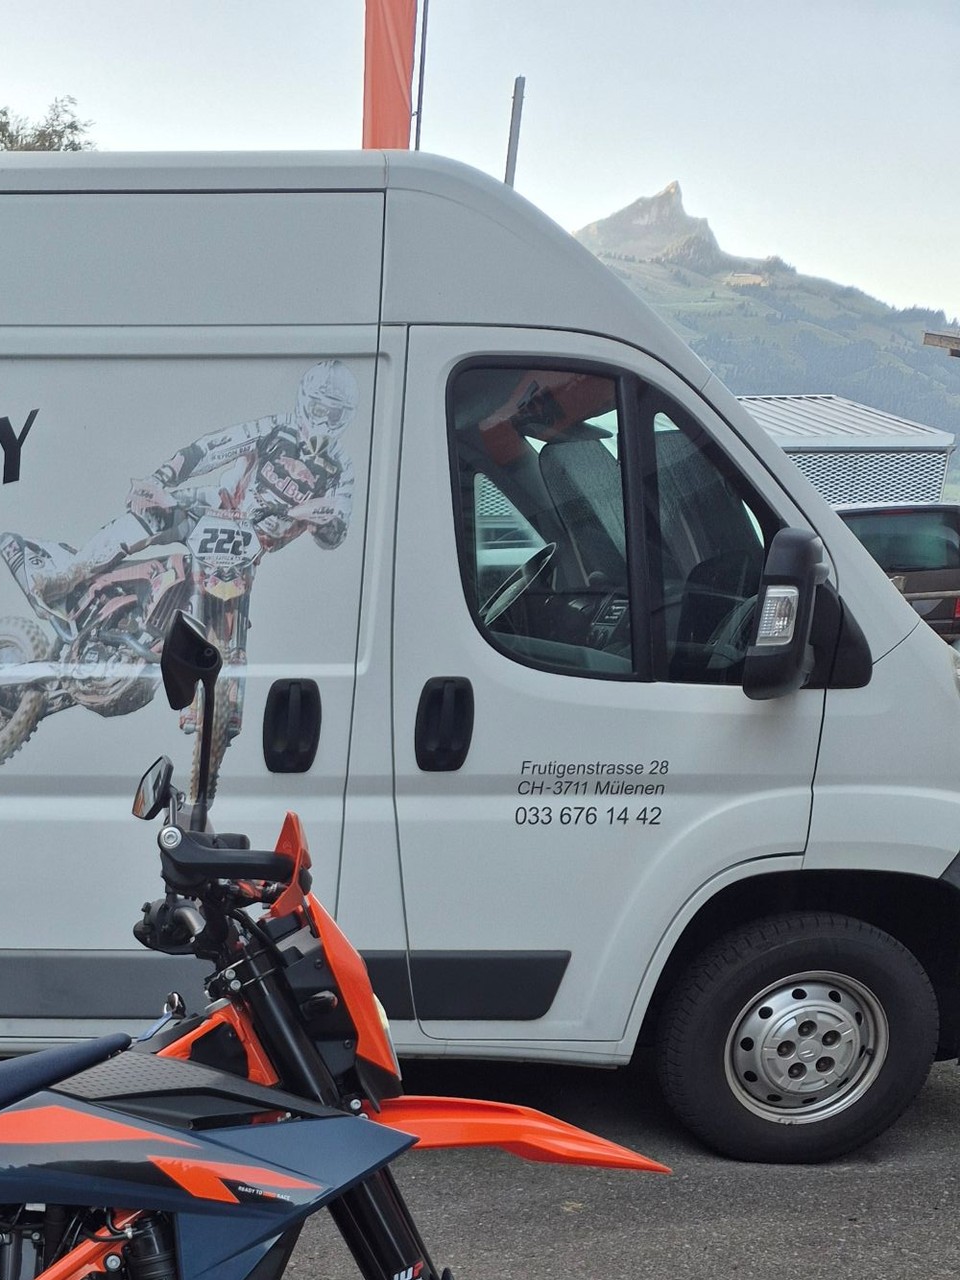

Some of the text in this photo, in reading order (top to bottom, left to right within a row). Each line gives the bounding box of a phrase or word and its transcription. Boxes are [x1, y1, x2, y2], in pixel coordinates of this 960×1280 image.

[197, 528, 253, 556] 222
[520, 760, 670, 778] Frutigenstrasse 28
[516, 780, 666, 796] CH-3711 Mülenen
[515, 806, 663, 825] 033 676 14 42
